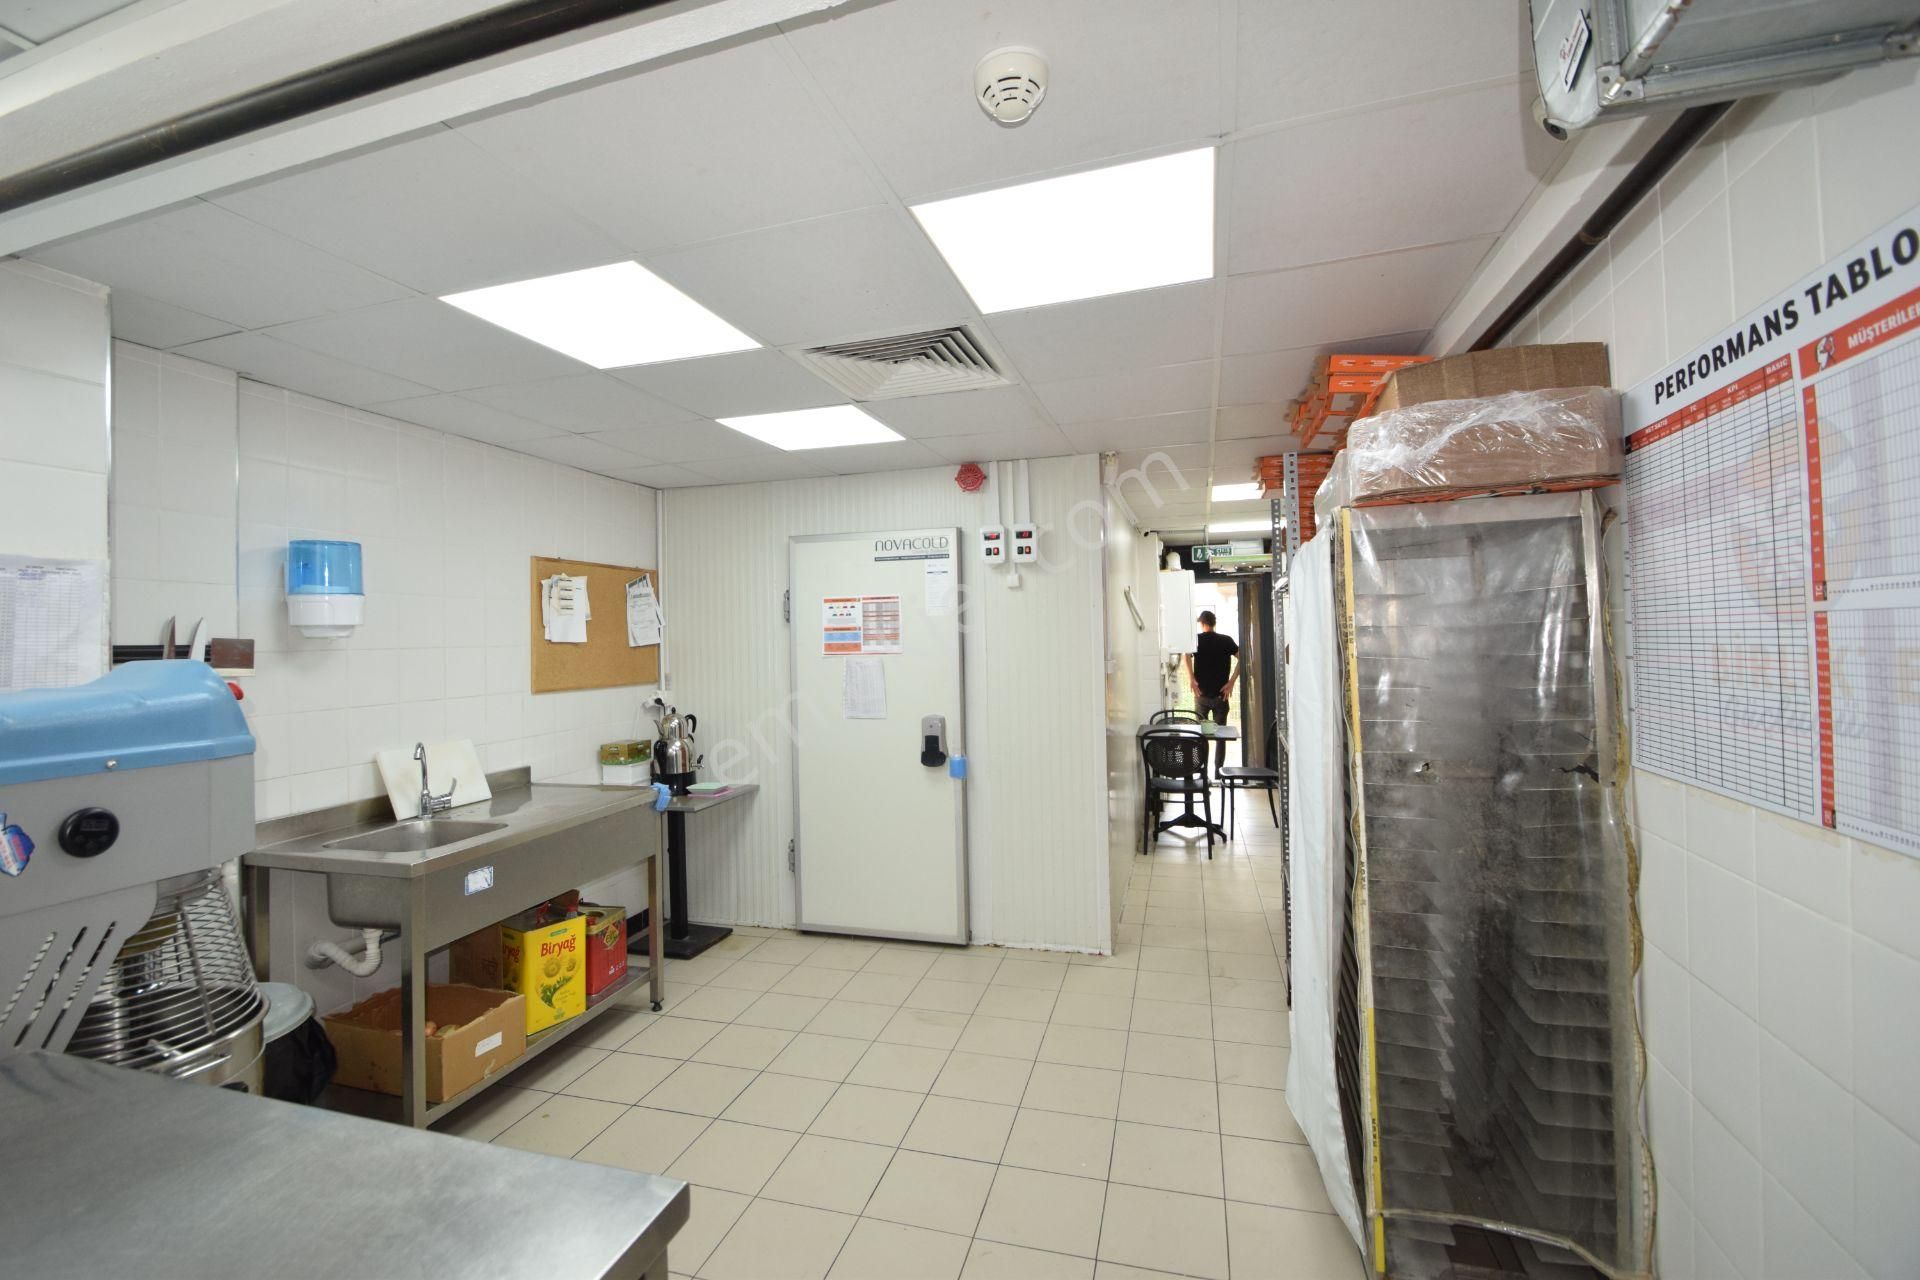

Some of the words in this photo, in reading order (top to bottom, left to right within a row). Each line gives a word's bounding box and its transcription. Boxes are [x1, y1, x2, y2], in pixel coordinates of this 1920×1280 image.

[1654, 299, 1799, 405] PERFORMANS
[1804, 228, 1920, 316] TABLO
[1766, 358, 1788, 374] BASIC
[1727, 384, 1738, 395] KPI
[875, 536, 949, 552] NOVACOLD
[541, 934, 576, 957] Biryağ
